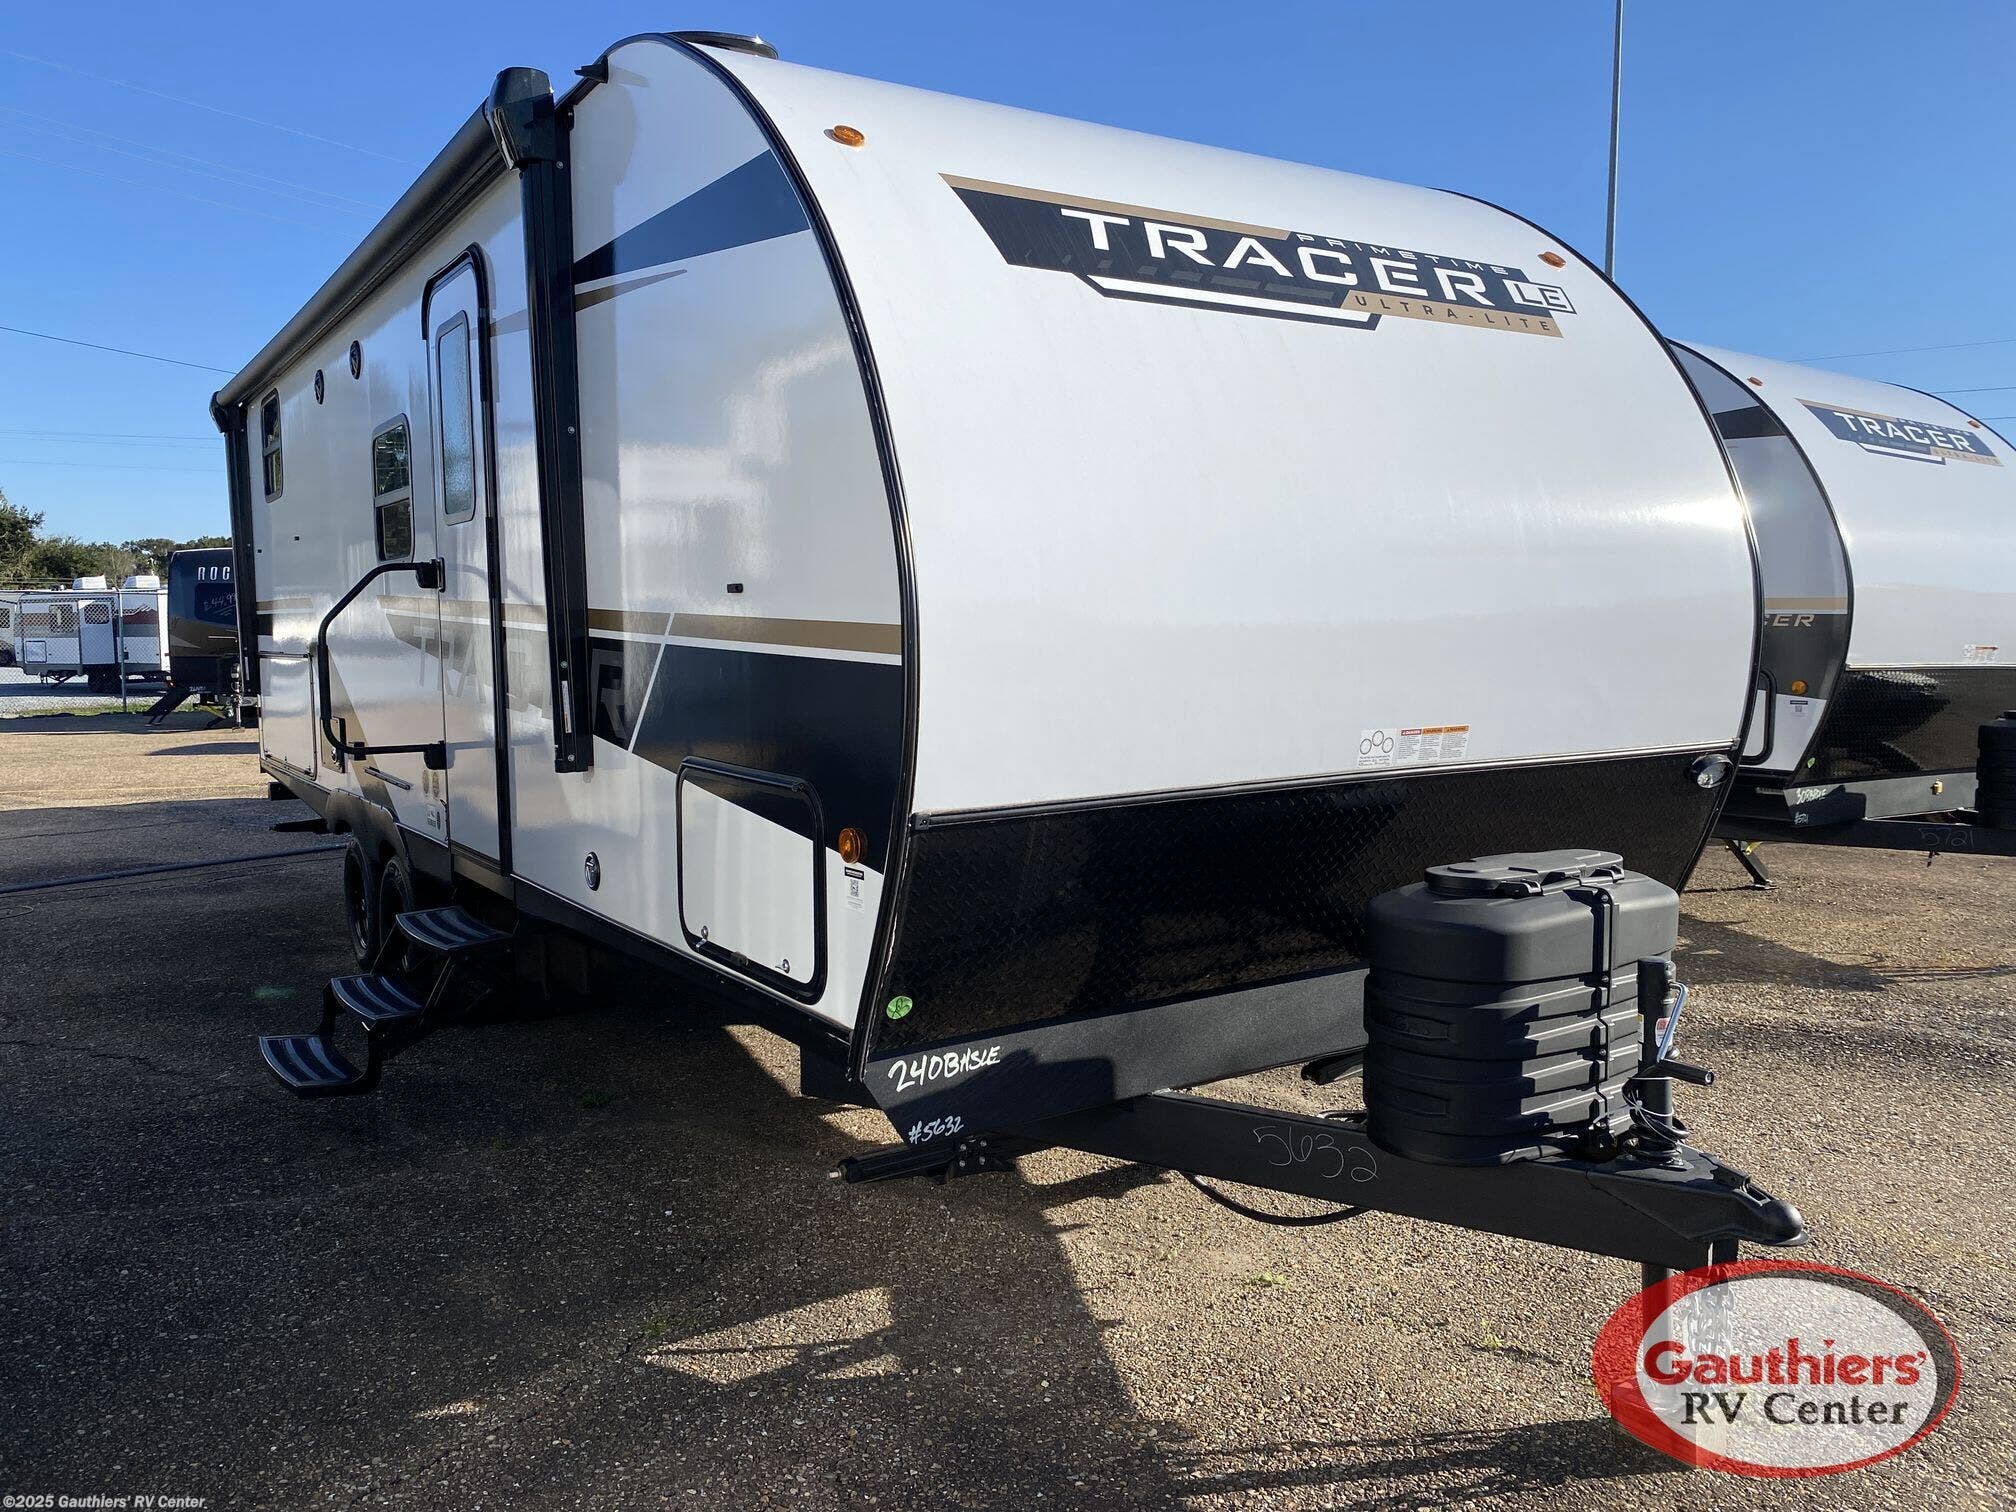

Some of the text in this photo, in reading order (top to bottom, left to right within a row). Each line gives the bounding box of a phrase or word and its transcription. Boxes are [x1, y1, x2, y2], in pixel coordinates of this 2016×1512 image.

[1061, 207, 1568, 310] TRACER LE
[1296, 233, 1510, 276] PRIMETIME
[1354, 296, 1552, 331] ULTRA-LITE
[1833, 411, 1977, 453] TRACER
[908, 1115, 965, 1145] #5632
[1252, 1125, 1380, 1184] 5632
